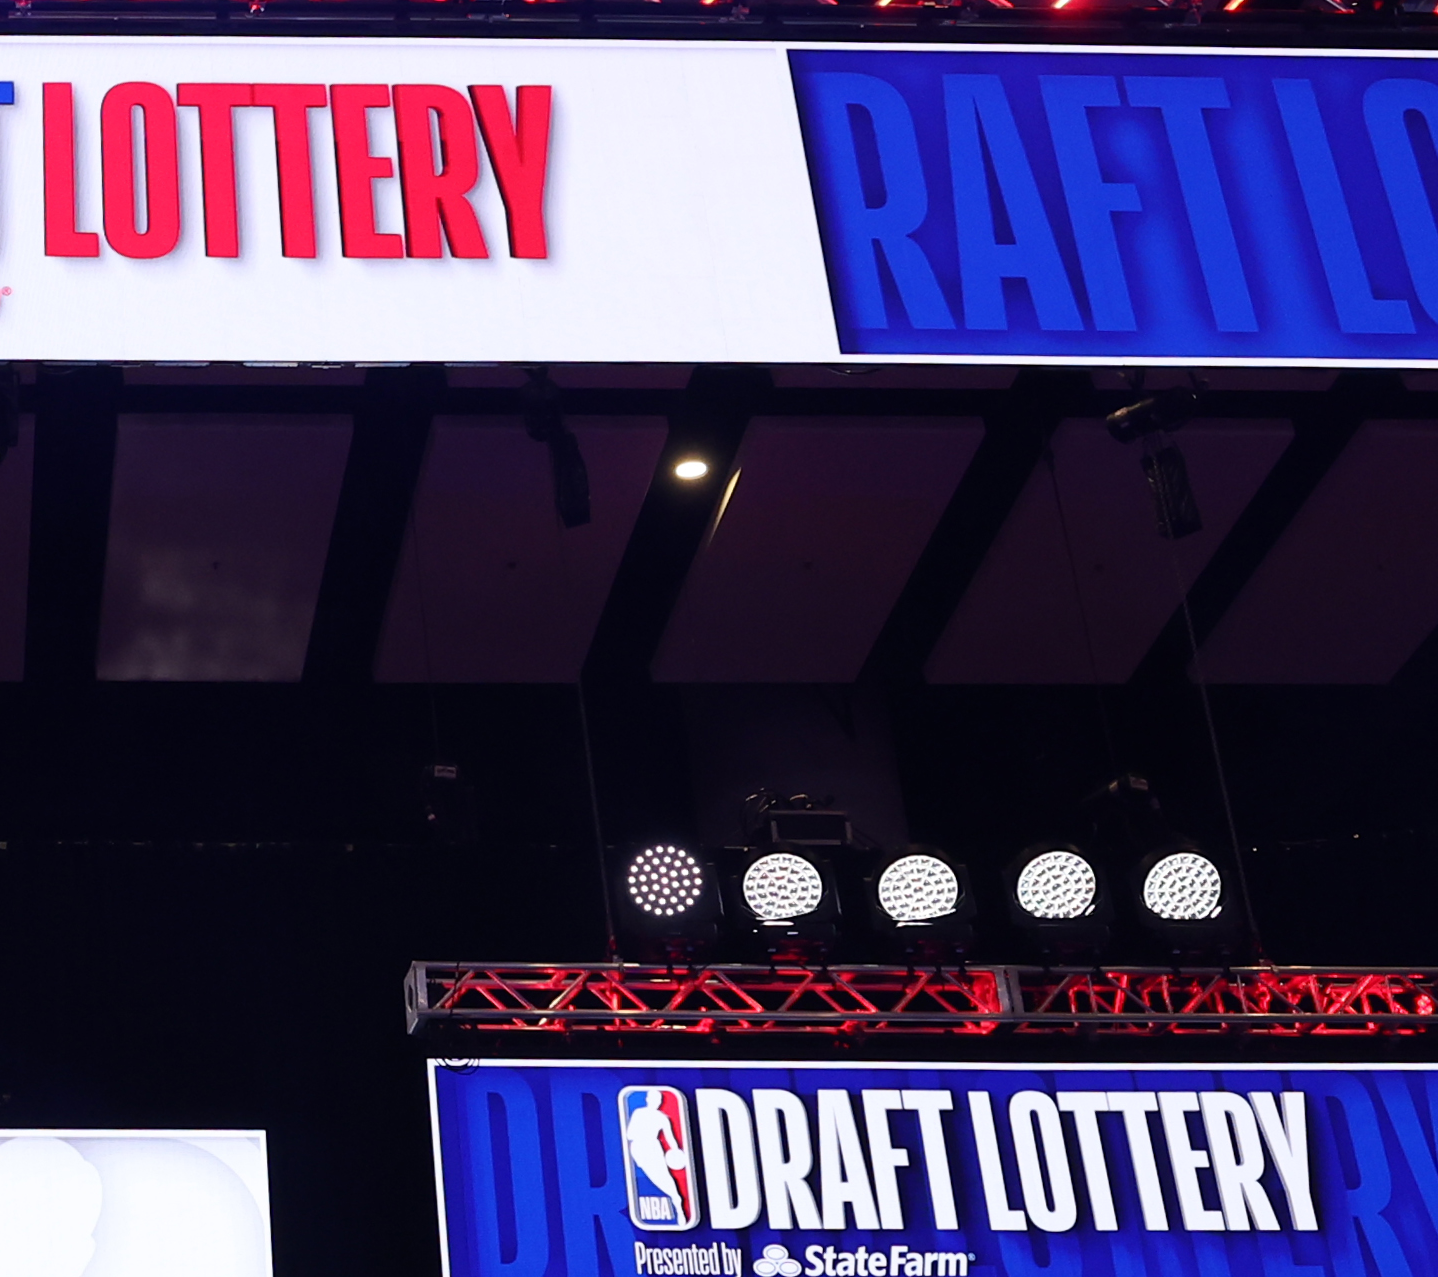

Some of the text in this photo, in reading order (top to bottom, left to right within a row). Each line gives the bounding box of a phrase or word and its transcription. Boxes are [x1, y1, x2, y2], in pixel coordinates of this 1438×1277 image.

[42, 80, 553, 259] LOTTERY
[808, 71, 1261, 334] RAFT
[638, 1195, 672, 1222] NBA
[695, 1087, 960, 1231] DRAFT
[967, 1089, 1319, 1232] LOTTERY
[633, 1241, 724, 1277] Presented
